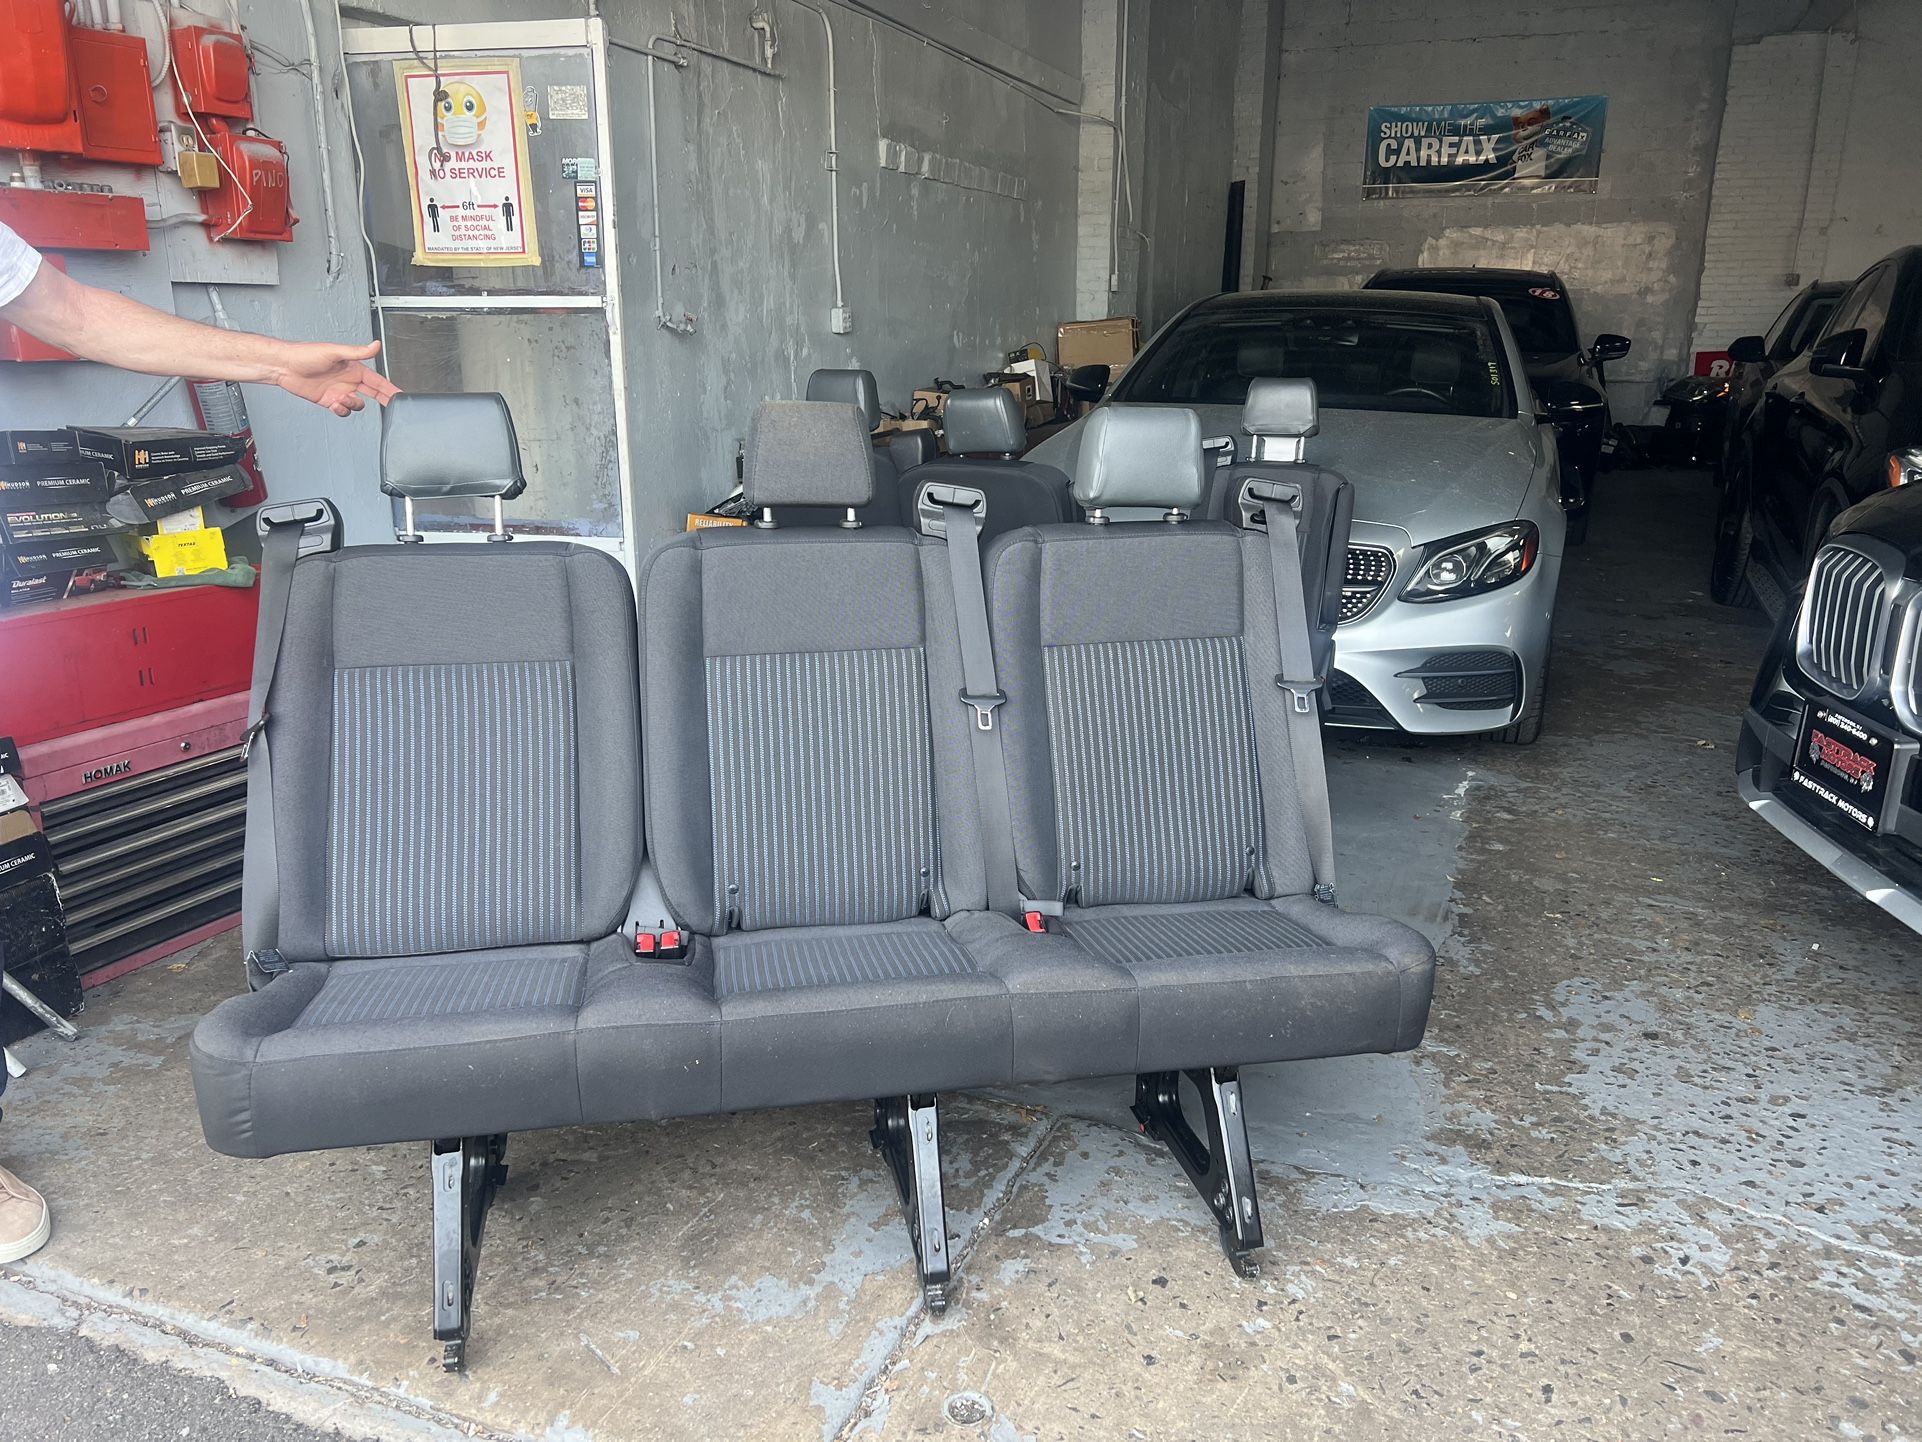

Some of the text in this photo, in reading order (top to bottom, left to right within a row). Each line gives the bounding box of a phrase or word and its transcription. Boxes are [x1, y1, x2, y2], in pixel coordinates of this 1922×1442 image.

[1380, 119, 1485, 138] SHOW ME THE
[1544, 128, 1588, 141] CARFAX
[1544, 137, 1581, 148] ADVANTAGE
[1378, 134, 1502, 168] CARFAX
[1548, 144, 1573, 154] DEALER
[455, 150, 494, 163] MASK
[429, 166, 506, 180] NO SERVICE
[462, 201, 476, 211] 6ft
[461, 214, 496, 222] MINDFUL
[464, 224, 493, 232] SOCIAL
[451, 233, 497, 242] DISTANCING
[91, 451, 115, 460] CERAMIC
[36, 479, 65, 487] PREMIUM
[65, 478, 91, 486] CERAMIC
[180, 482, 209, 495] PREMIUM
[207, 475, 233, 488] CERAMIC
[7, 512, 68, 524] EVOLUTION
[51, 550, 78, 558] PREMIUM
[77, 547, 101, 556] CERAMIC
[11, 575, 47, 588] Duralast
[82, 760, 132, 785] HOMAK
[1798, 774, 1868, 824] FASTTRACK MOTORS
[10, 852, 36, 867] CERAMIC
